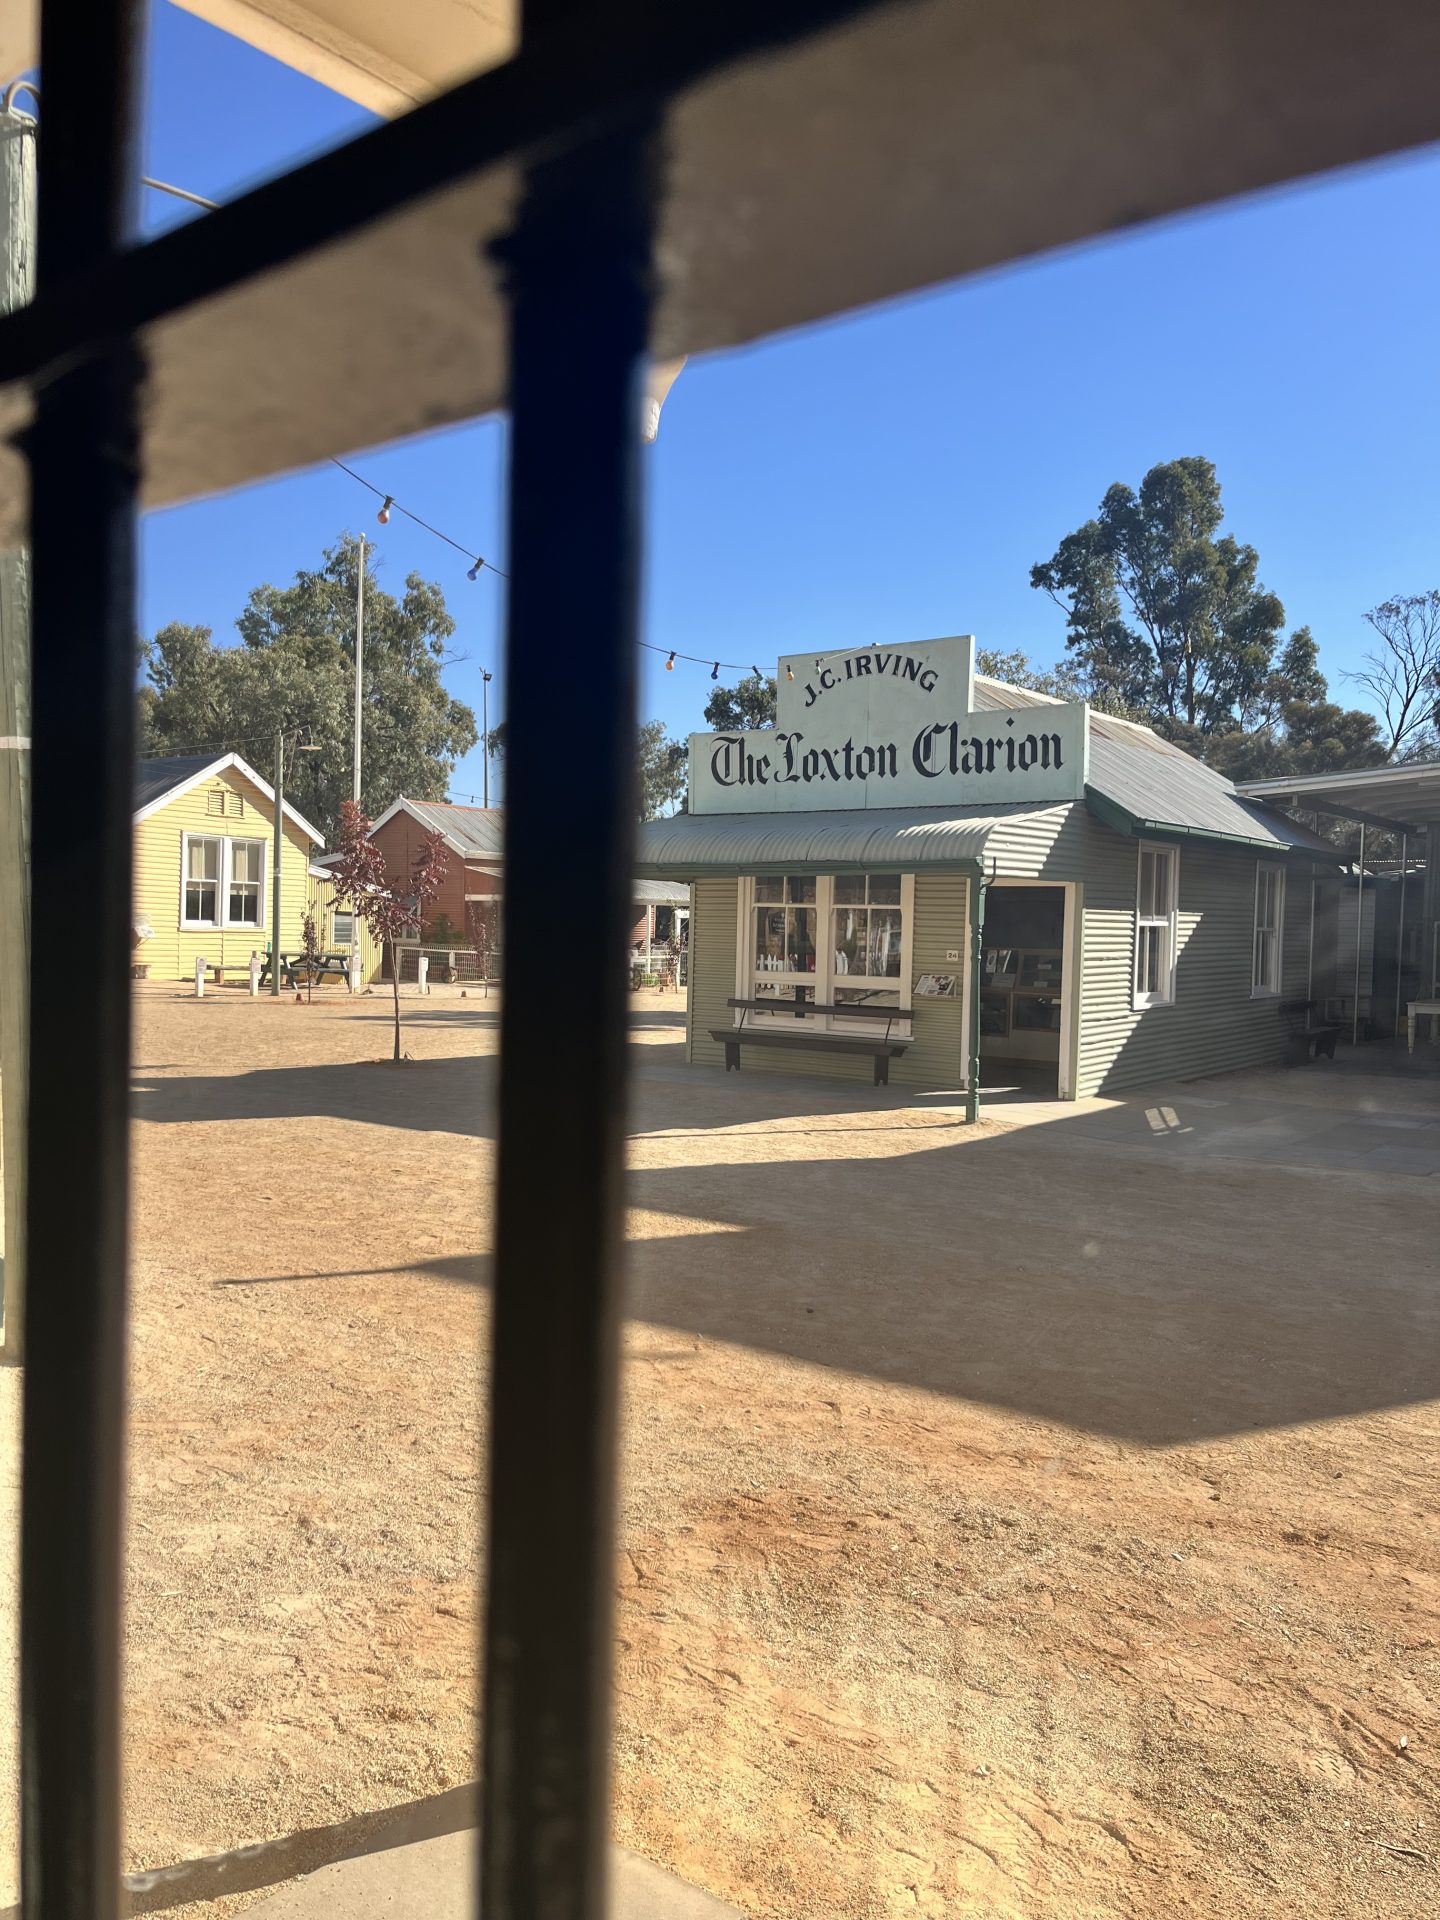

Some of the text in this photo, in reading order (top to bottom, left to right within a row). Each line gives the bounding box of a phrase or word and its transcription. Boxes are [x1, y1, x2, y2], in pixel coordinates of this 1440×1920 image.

[804, 653, 939, 707] J.C. IRVING
[710, 717, 1064, 787] The Loxton Clarion
[947, 952, 958, 960] 24
